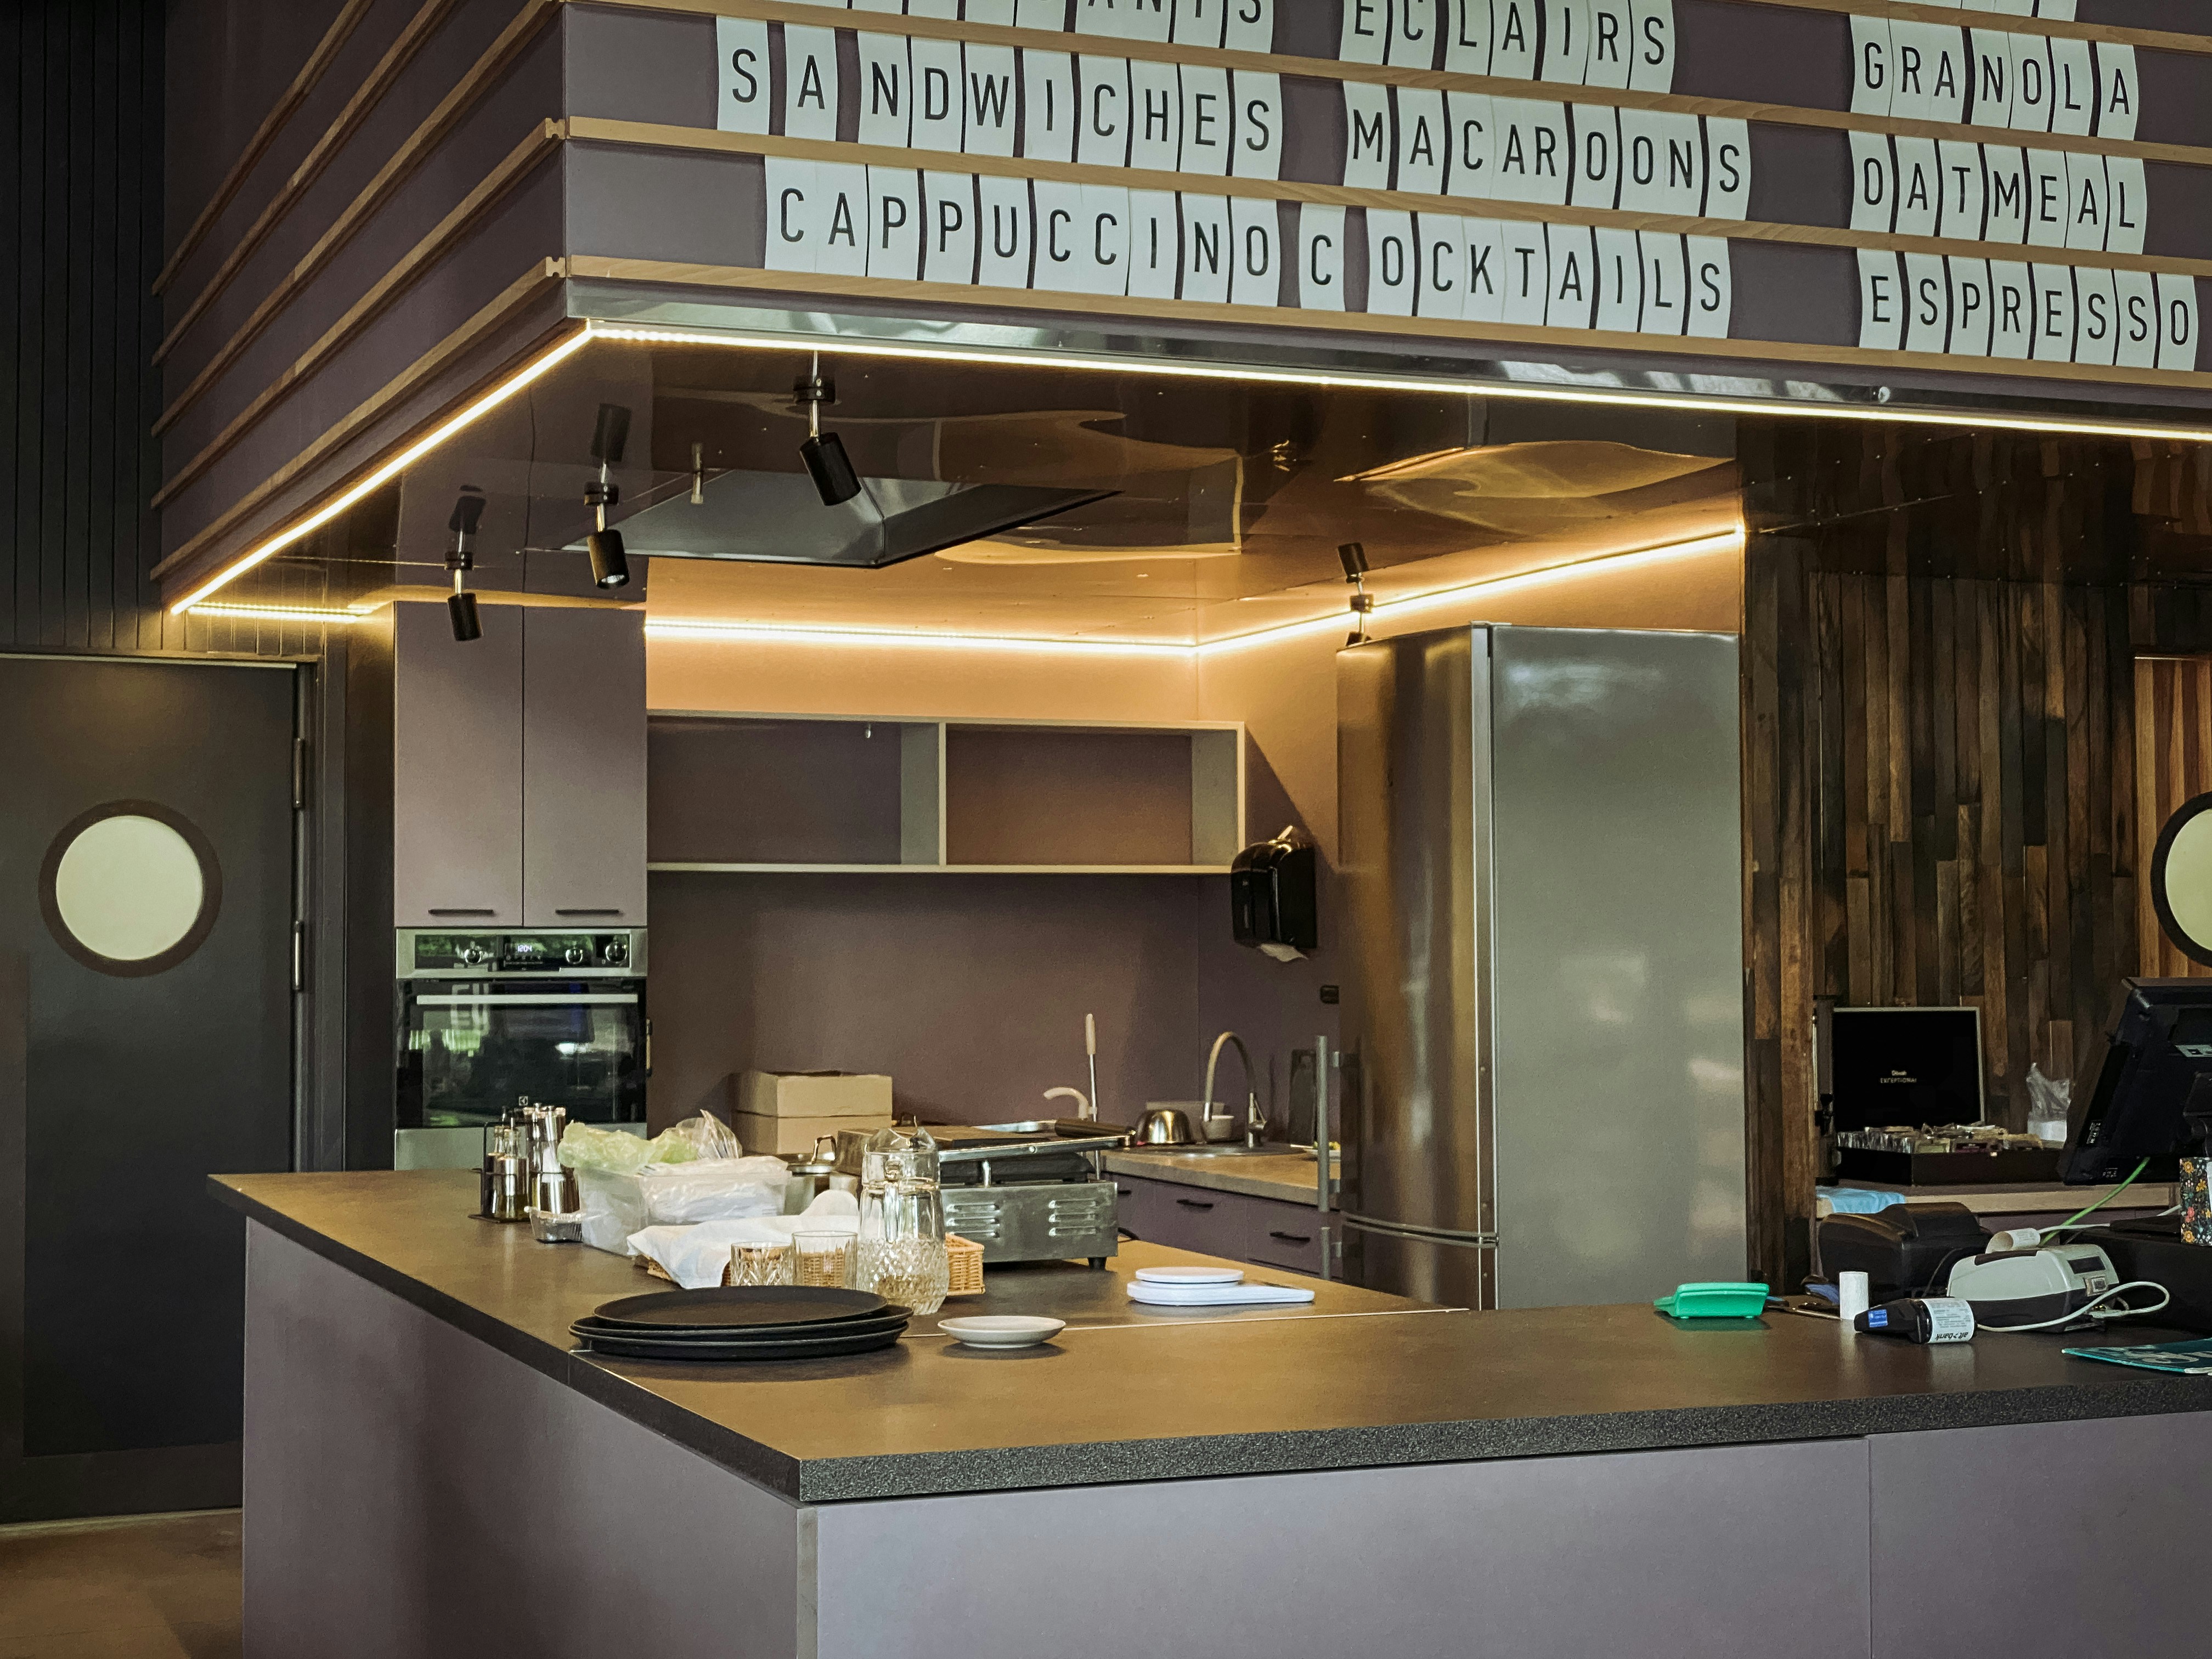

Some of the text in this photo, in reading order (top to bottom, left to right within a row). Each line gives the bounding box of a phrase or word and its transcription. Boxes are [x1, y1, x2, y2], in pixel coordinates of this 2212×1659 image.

[1355, 0, 1664, 65] ECLAIRS
[732, 48, 1269, 151] SANDWICHES
[1865, 42, 2129, 115] GRANOLA
[1353, 109, 1739, 192] MACAROONS
[1864, 158, 2135, 228] OATMEAL
[781, 188, 1268, 275] CAPPUCCINO
[1871, 275, 2189, 346] ESPRESSO
